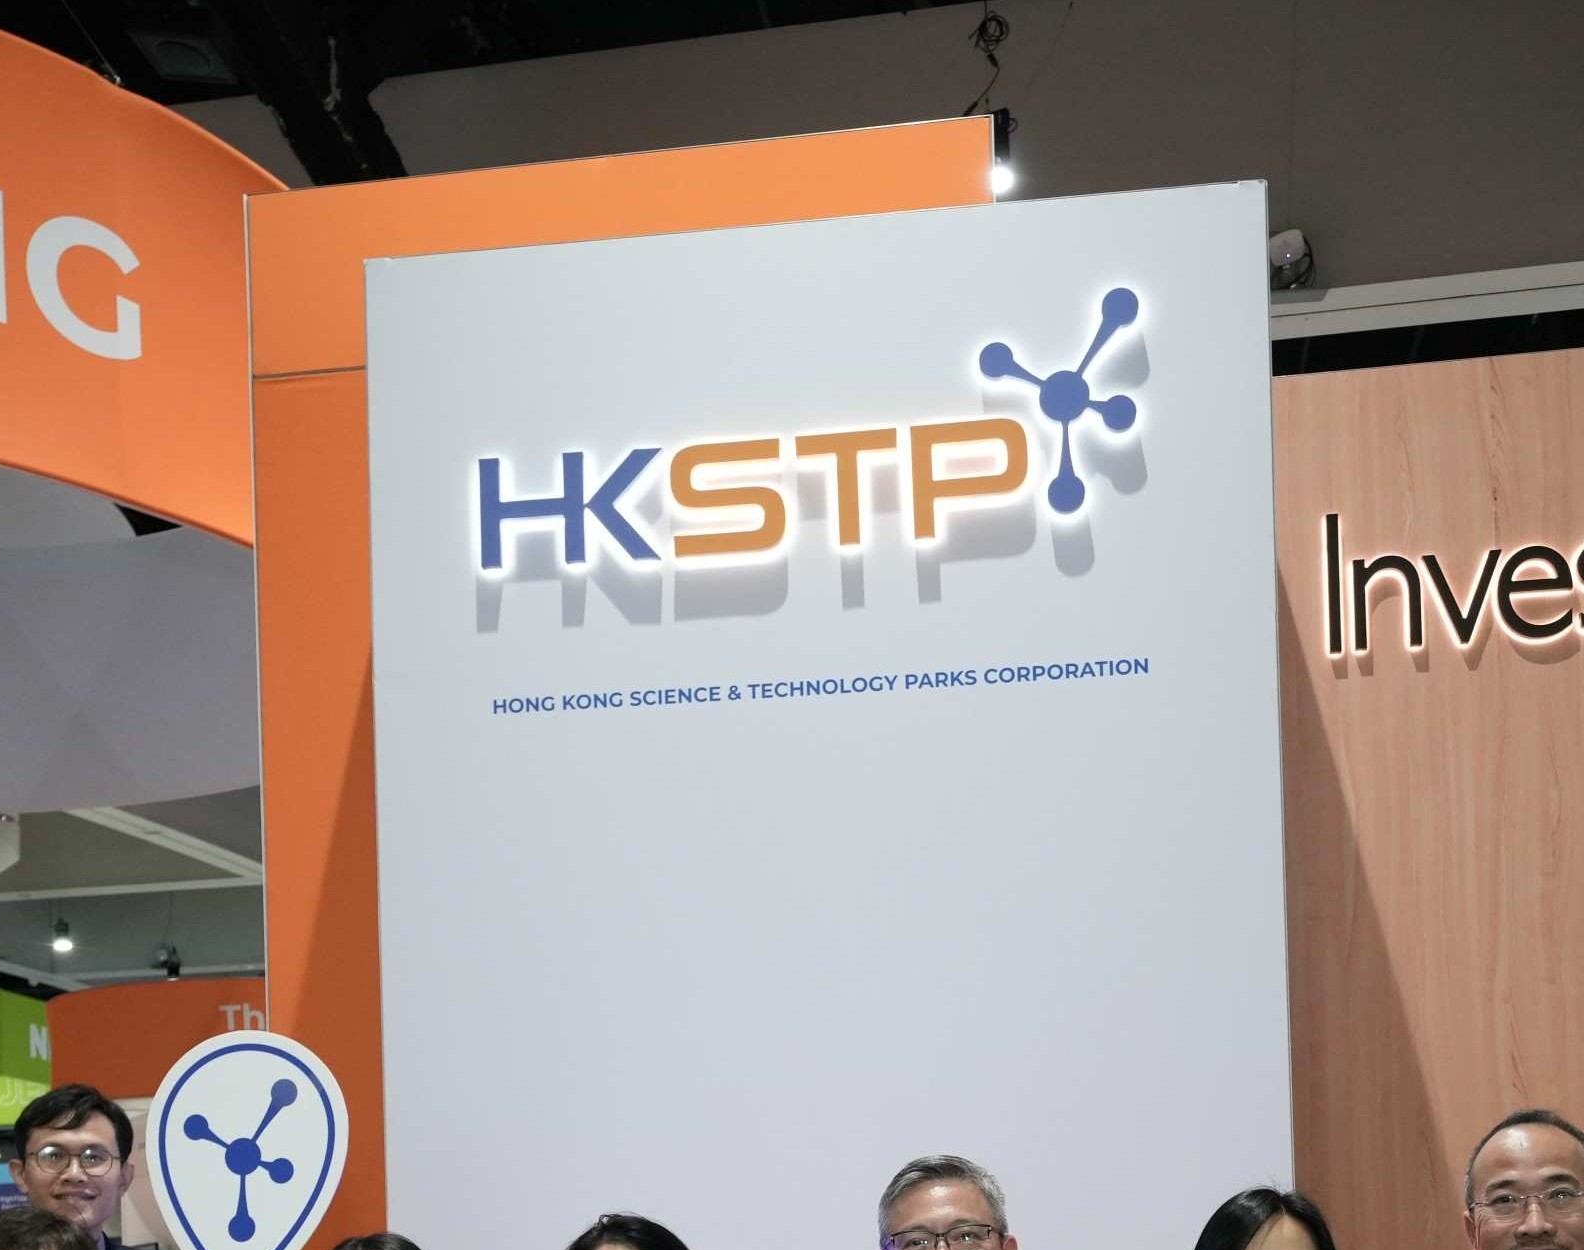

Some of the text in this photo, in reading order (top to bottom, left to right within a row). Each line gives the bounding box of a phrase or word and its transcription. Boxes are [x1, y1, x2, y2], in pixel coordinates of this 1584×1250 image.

[478, 417, 1029, 570] HKSTP
[492, 657, 1151, 715] HONG KONG SCIENCE & TECHNOLOGY PARKS CORPORATION
[218, 1002, 265, 1030] Th
